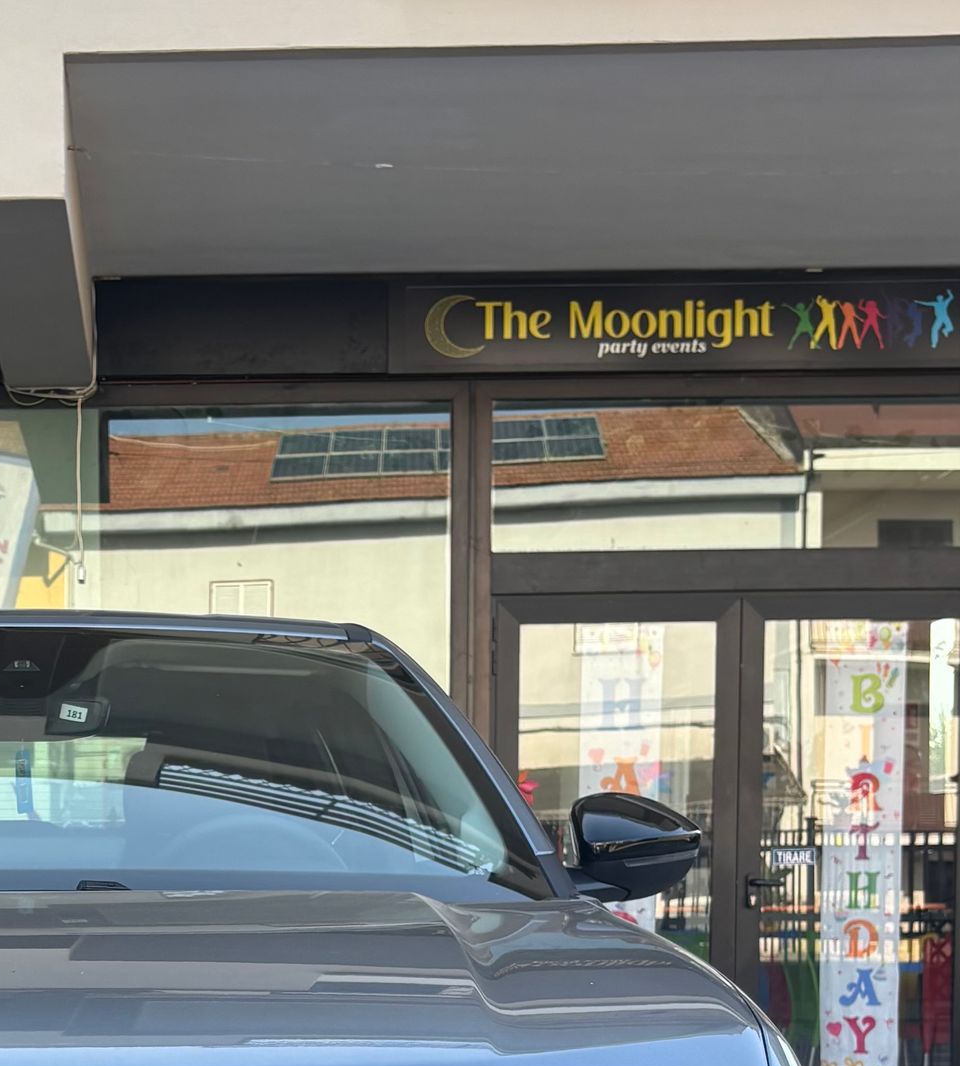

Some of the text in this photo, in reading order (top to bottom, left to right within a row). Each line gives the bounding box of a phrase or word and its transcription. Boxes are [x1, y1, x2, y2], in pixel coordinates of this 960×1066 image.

[476, 299, 775, 349] The Moonlight
[597, 339, 707, 359] party events
[66, 709, 83, 720] 181
[776, 850, 813, 864] TIRARE
